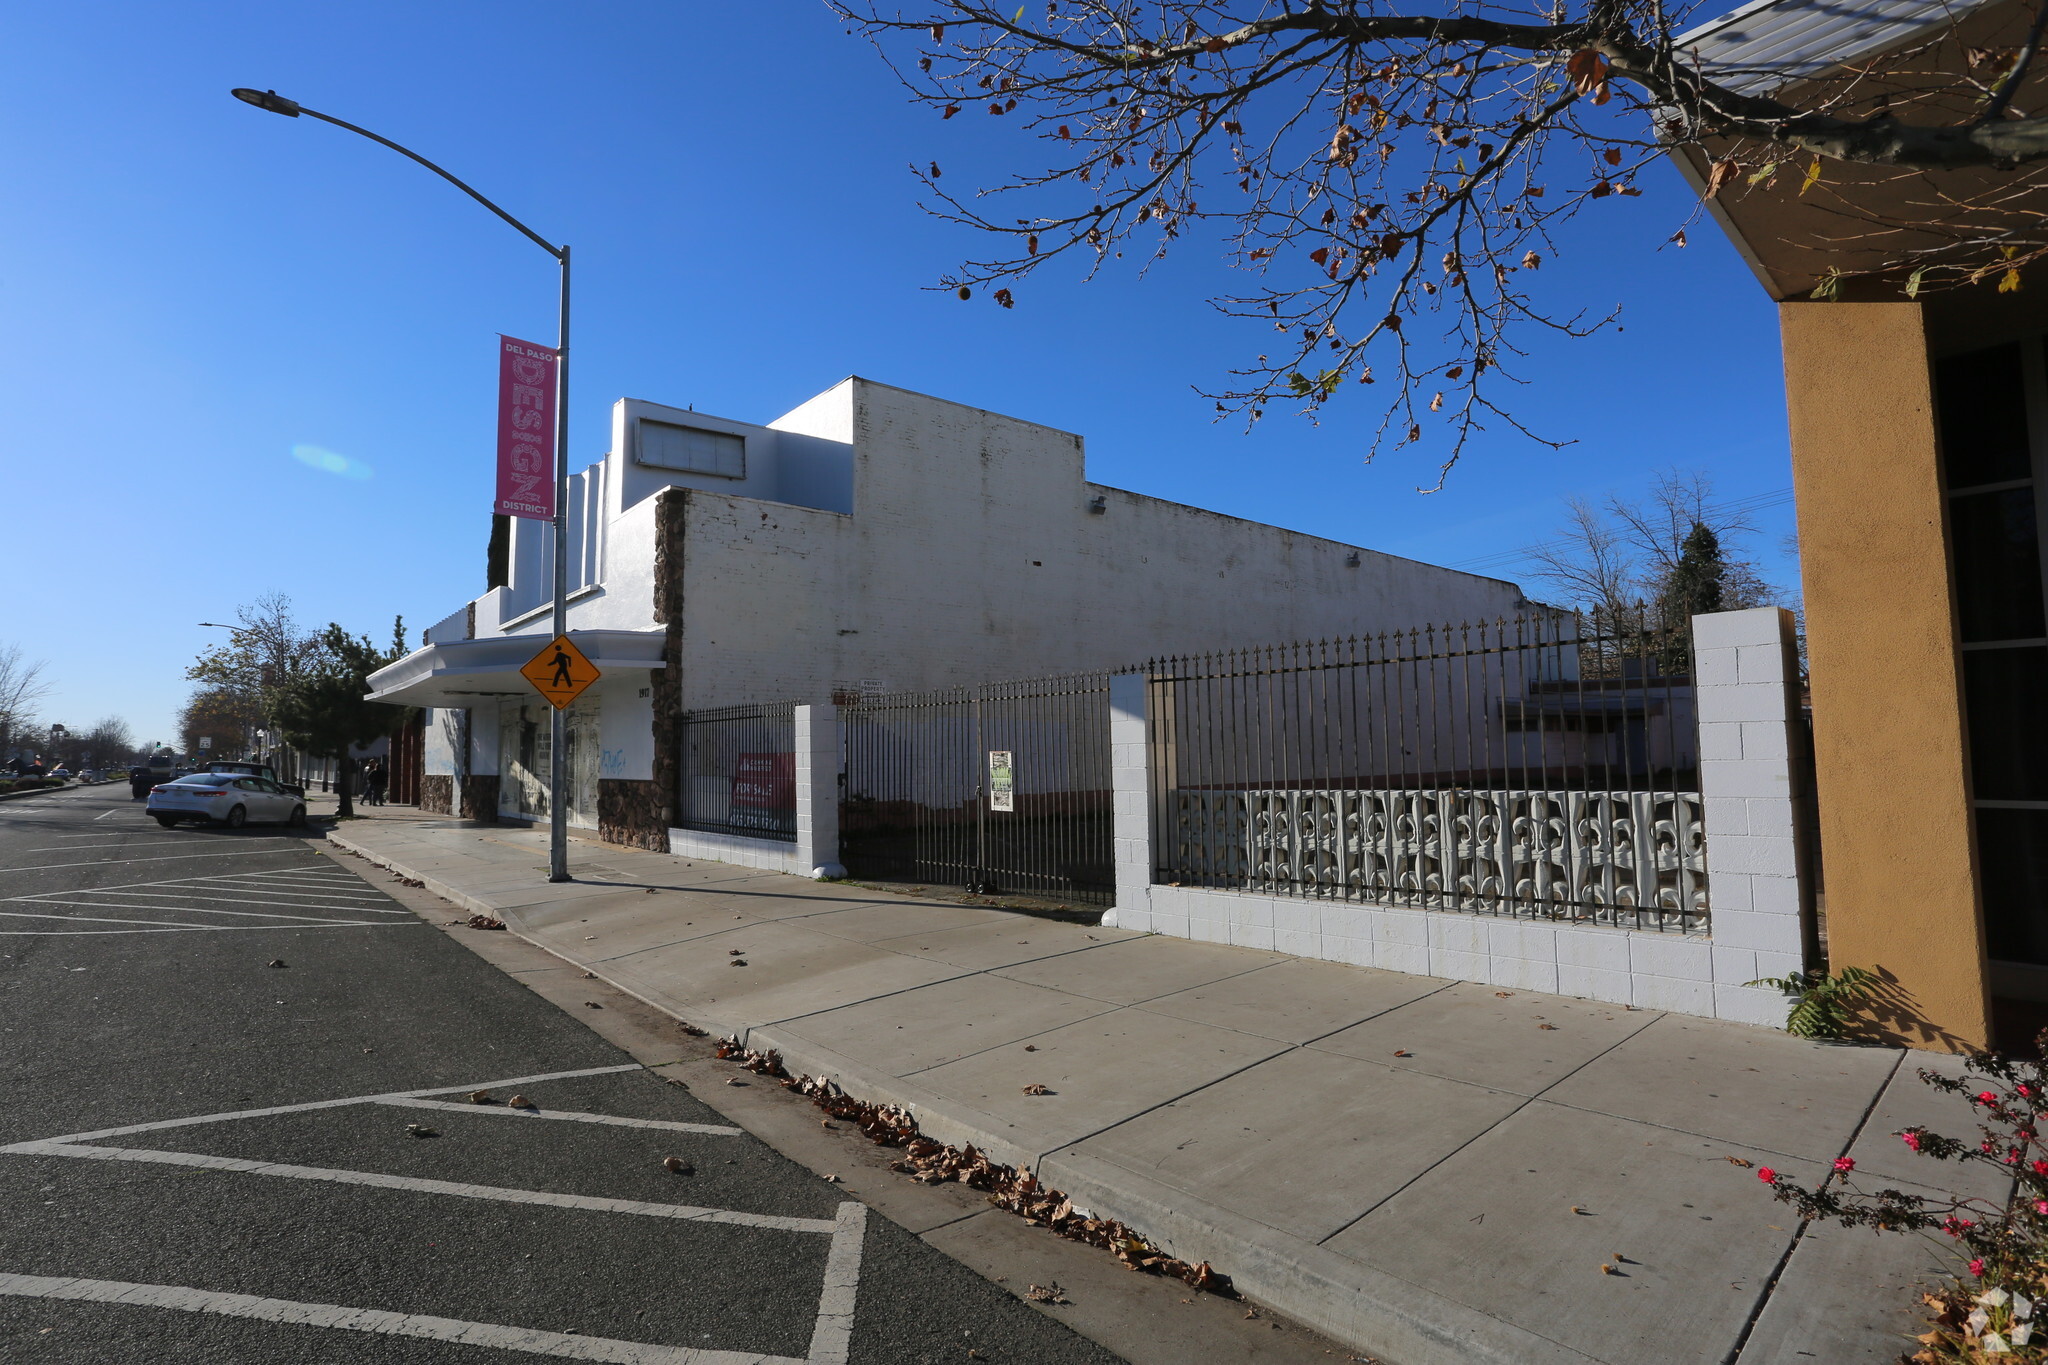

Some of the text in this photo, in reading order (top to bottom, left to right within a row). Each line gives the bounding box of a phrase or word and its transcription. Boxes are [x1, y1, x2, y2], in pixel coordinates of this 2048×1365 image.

[505, 343, 553, 362] DEL PASO
[509, 354, 546, 503] DESIGN
[503, 500, 547, 514] DISTRICT
